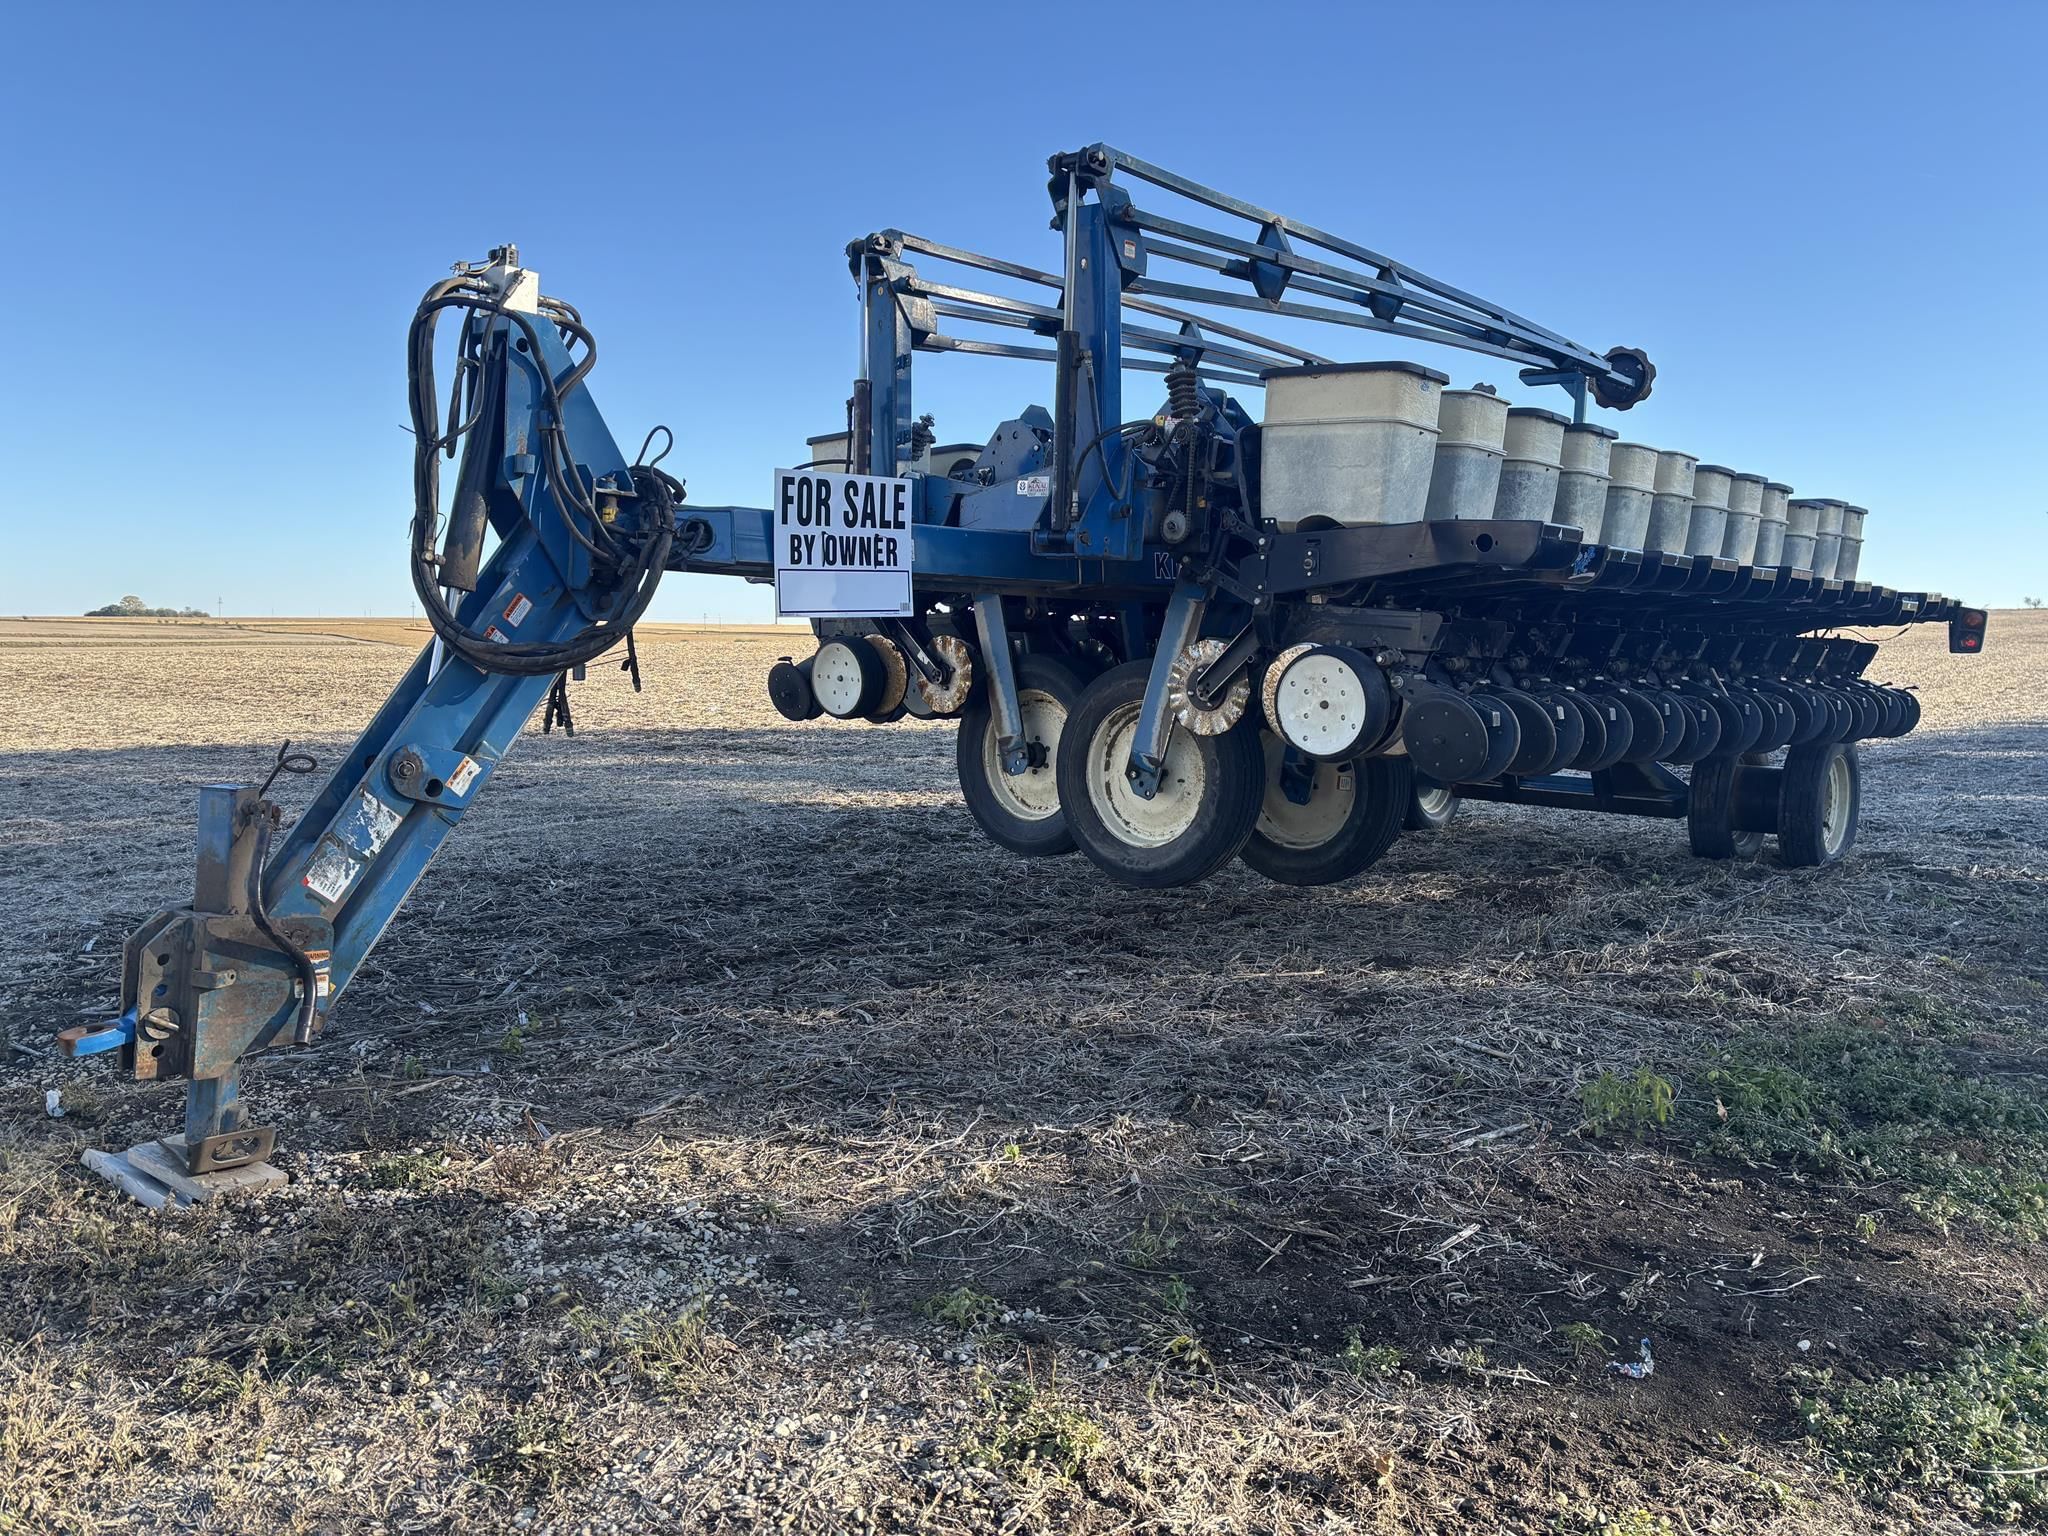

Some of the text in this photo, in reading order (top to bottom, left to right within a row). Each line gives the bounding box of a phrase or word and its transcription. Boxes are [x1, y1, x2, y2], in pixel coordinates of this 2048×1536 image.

[781, 476, 906, 530] FOR SALE
[790, 534, 898, 567] BY OWNER
